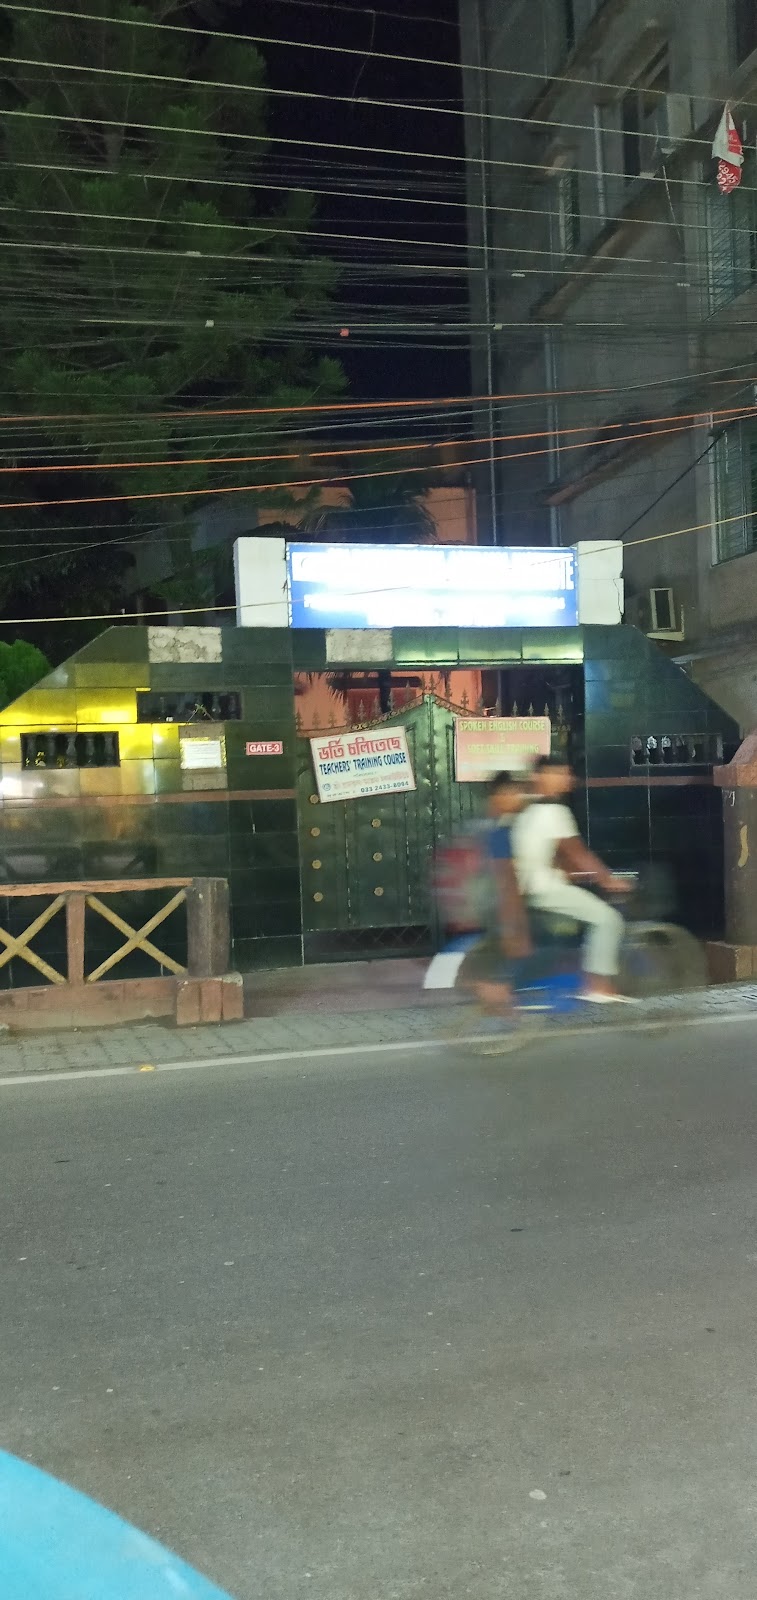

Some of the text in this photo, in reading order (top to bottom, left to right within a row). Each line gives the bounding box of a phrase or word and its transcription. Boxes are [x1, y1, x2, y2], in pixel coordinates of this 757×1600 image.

[460, 720, 546, 732] SPOKEN ENGLISH COURSE
[249, 744, 281, 753] GATE-3
[317, 736, 402, 760] ভর্তি চলিতেছে
[319, 760, 352, 776] TEACHERS'
[353, 756, 383, 770] TRAINING
[384, 752, 408, 766] COURSE
